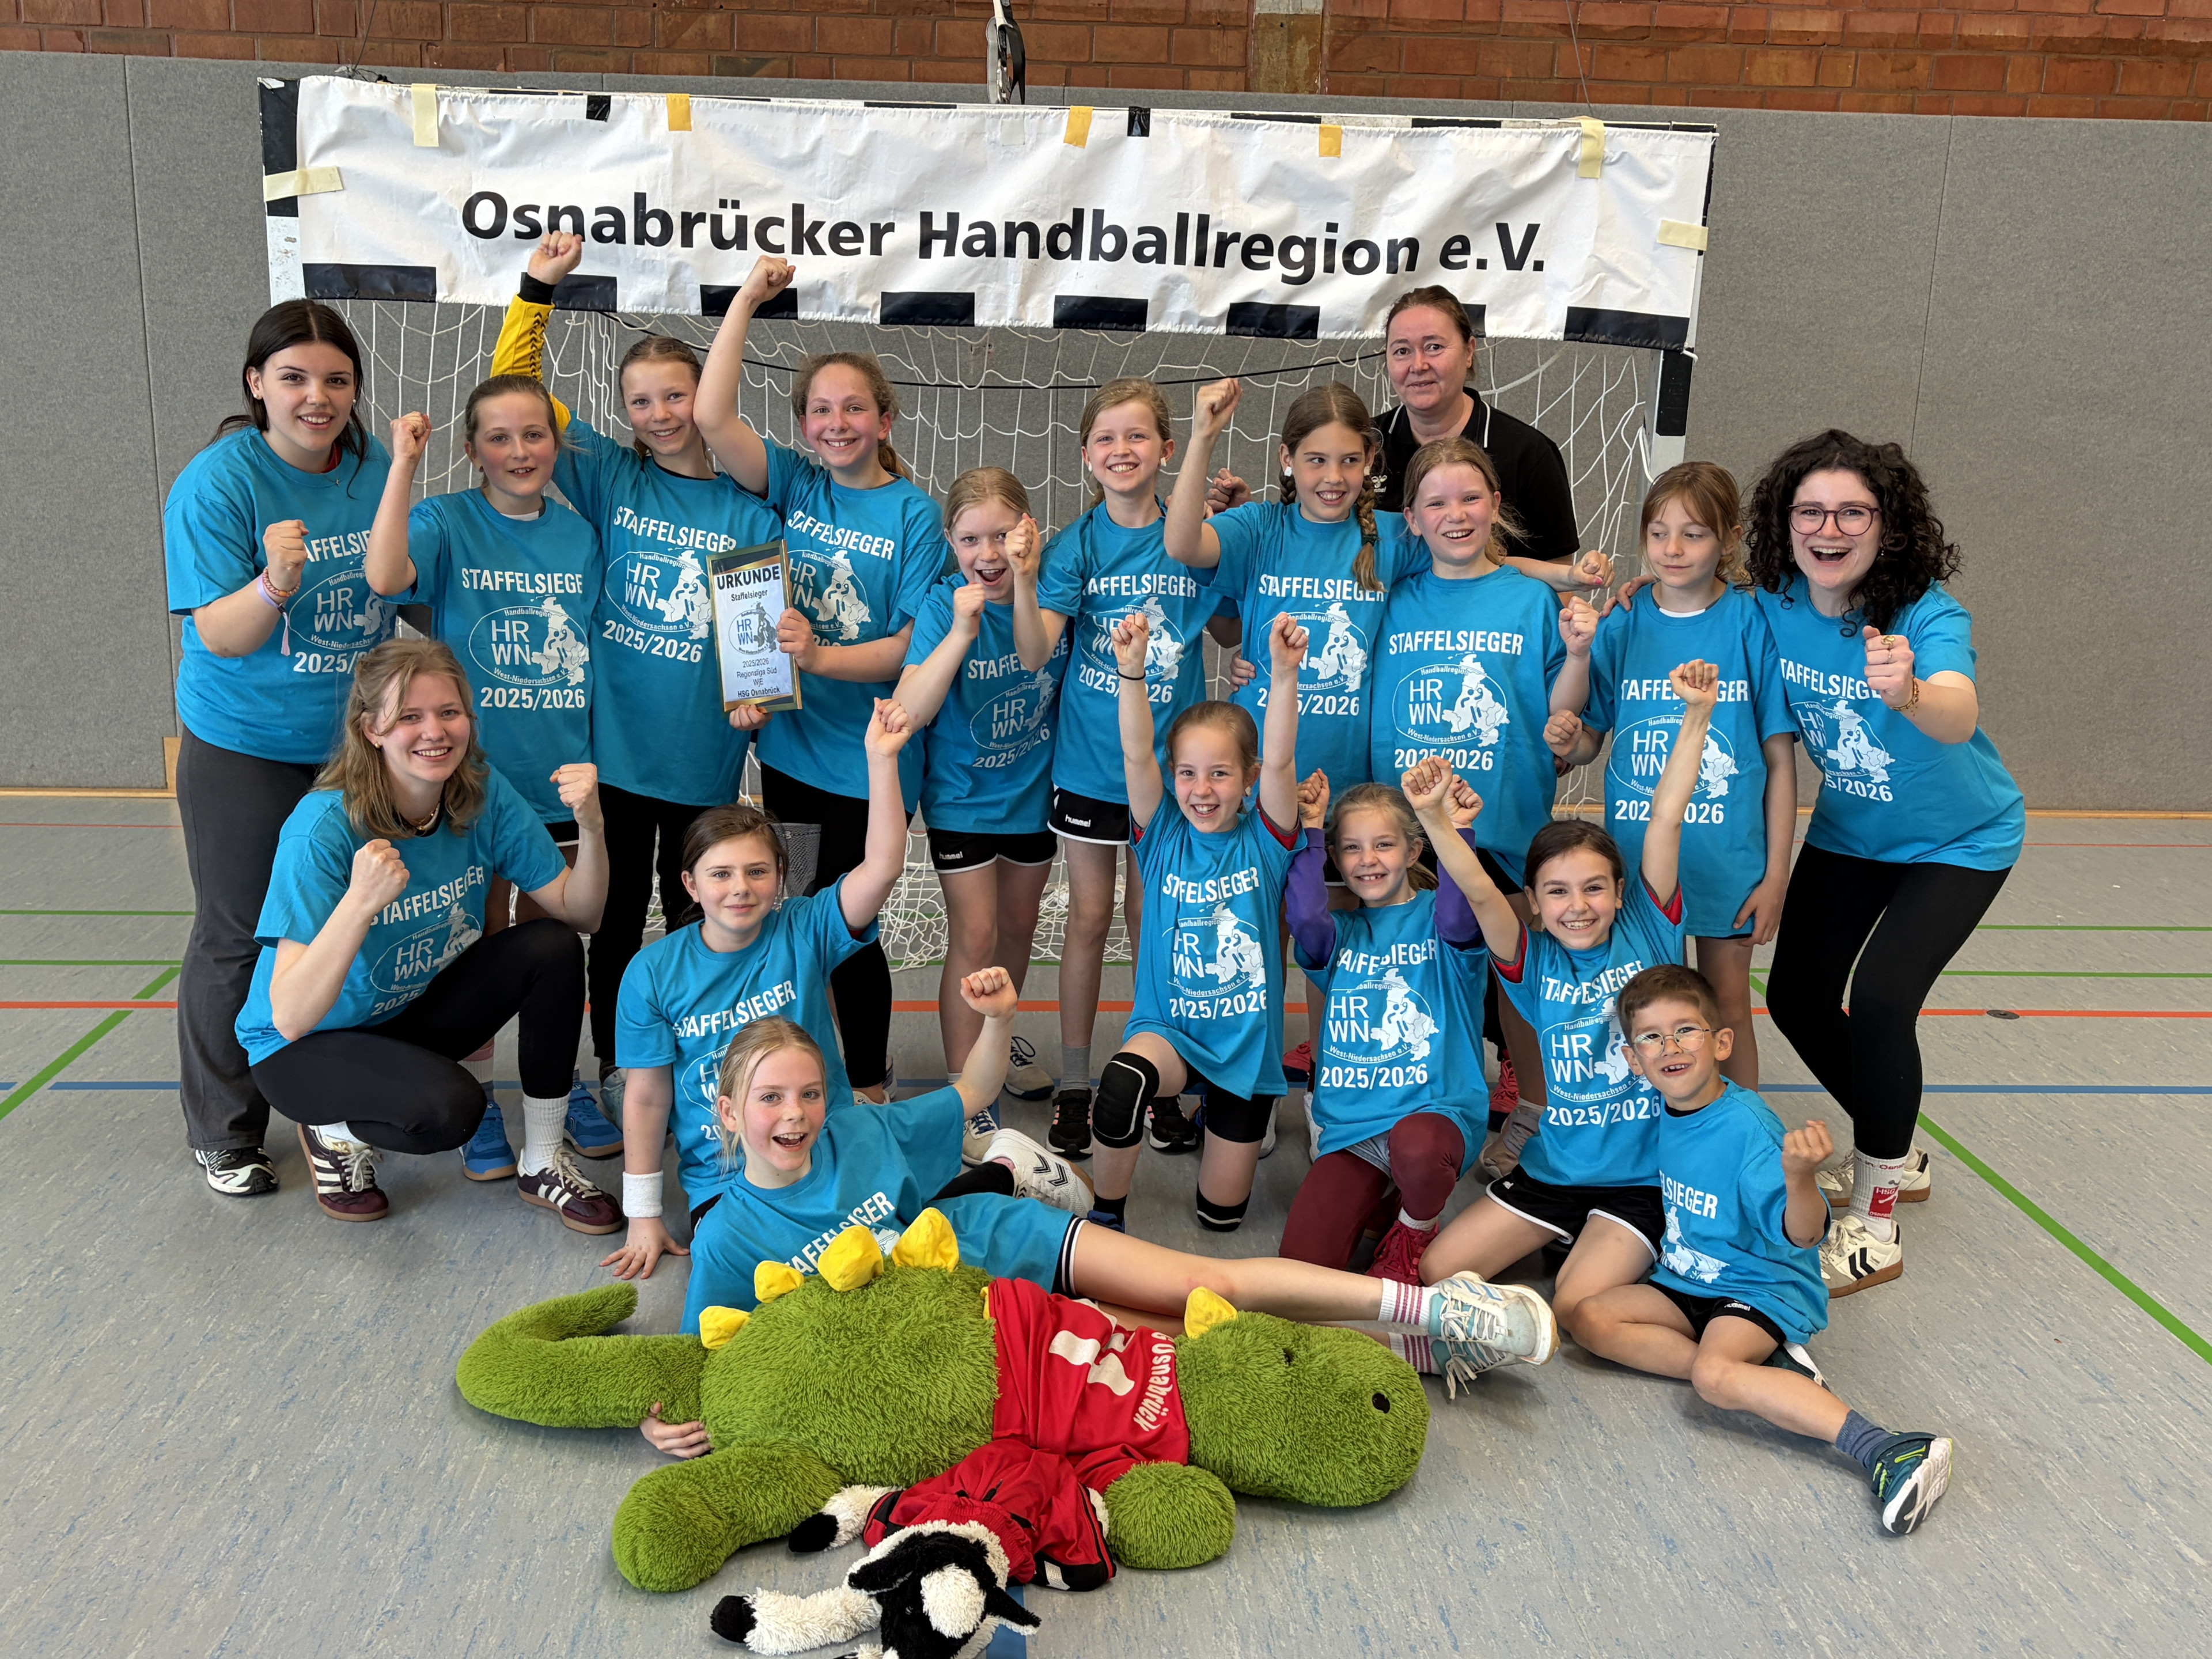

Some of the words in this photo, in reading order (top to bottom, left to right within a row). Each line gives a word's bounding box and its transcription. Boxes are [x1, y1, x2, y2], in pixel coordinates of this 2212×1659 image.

[461, 191, 896, 257] Osnabrücker
[919, 207, 1420, 286] Handballregion
[1438, 222, 1544, 272] e.V.
[613, 506, 737, 553] STAFFELSIEGER
[626, 559, 661, 589] HR
[717, 566, 780, 590] URKUNDE
[789, 558, 817, 587] HR
[317, 587, 354, 613] HR
[625, 581, 657, 610] WN
[731, 590, 768, 602] Staffelsieger
[314, 609, 353, 632] WN
[504, 608, 552, 618] Handballregion
[491, 620, 530, 643] HR
[737, 618, 752, 632] HR
[602, 620, 703, 663] 2025/2026
[737, 631, 753, 646] WN
[1389, 630, 1524, 656] STAFFELSIEGER
[491, 643, 532, 665] WN
[743, 658, 769, 668] 2025/2026
[494, 667, 556, 684] West-Niedersachsen
[1421, 665, 1468, 676] Handballregion
[480, 687, 586, 711] 2025/2026
[751, 686, 780, 696] Osnabrück
[1410, 679, 1443, 702] HR
[993, 698, 1027, 721] HR
[1408, 702, 1441, 725] WN
[991, 715, 1024, 739] WN
[1633, 730, 1669, 753] HR
[1631, 754, 1667, 776] WN
[1065, 814, 1091, 828] hummel
[396, 938, 434, 965] HR
[394, 955, 433, 982] WN
[1172, 952, 1205, 979] WN
[1330, 996, 1369, 1018] HR
[1328, 1020, 1369, 1043] WN
[1551, 1033, 1593, 1058] HR
[1320, 1063, 1429, 1090] 2025/2026
[1551, 1057, 1594, 1084] WN
[1547, 1096, 1661, 1128] 2025/2026
